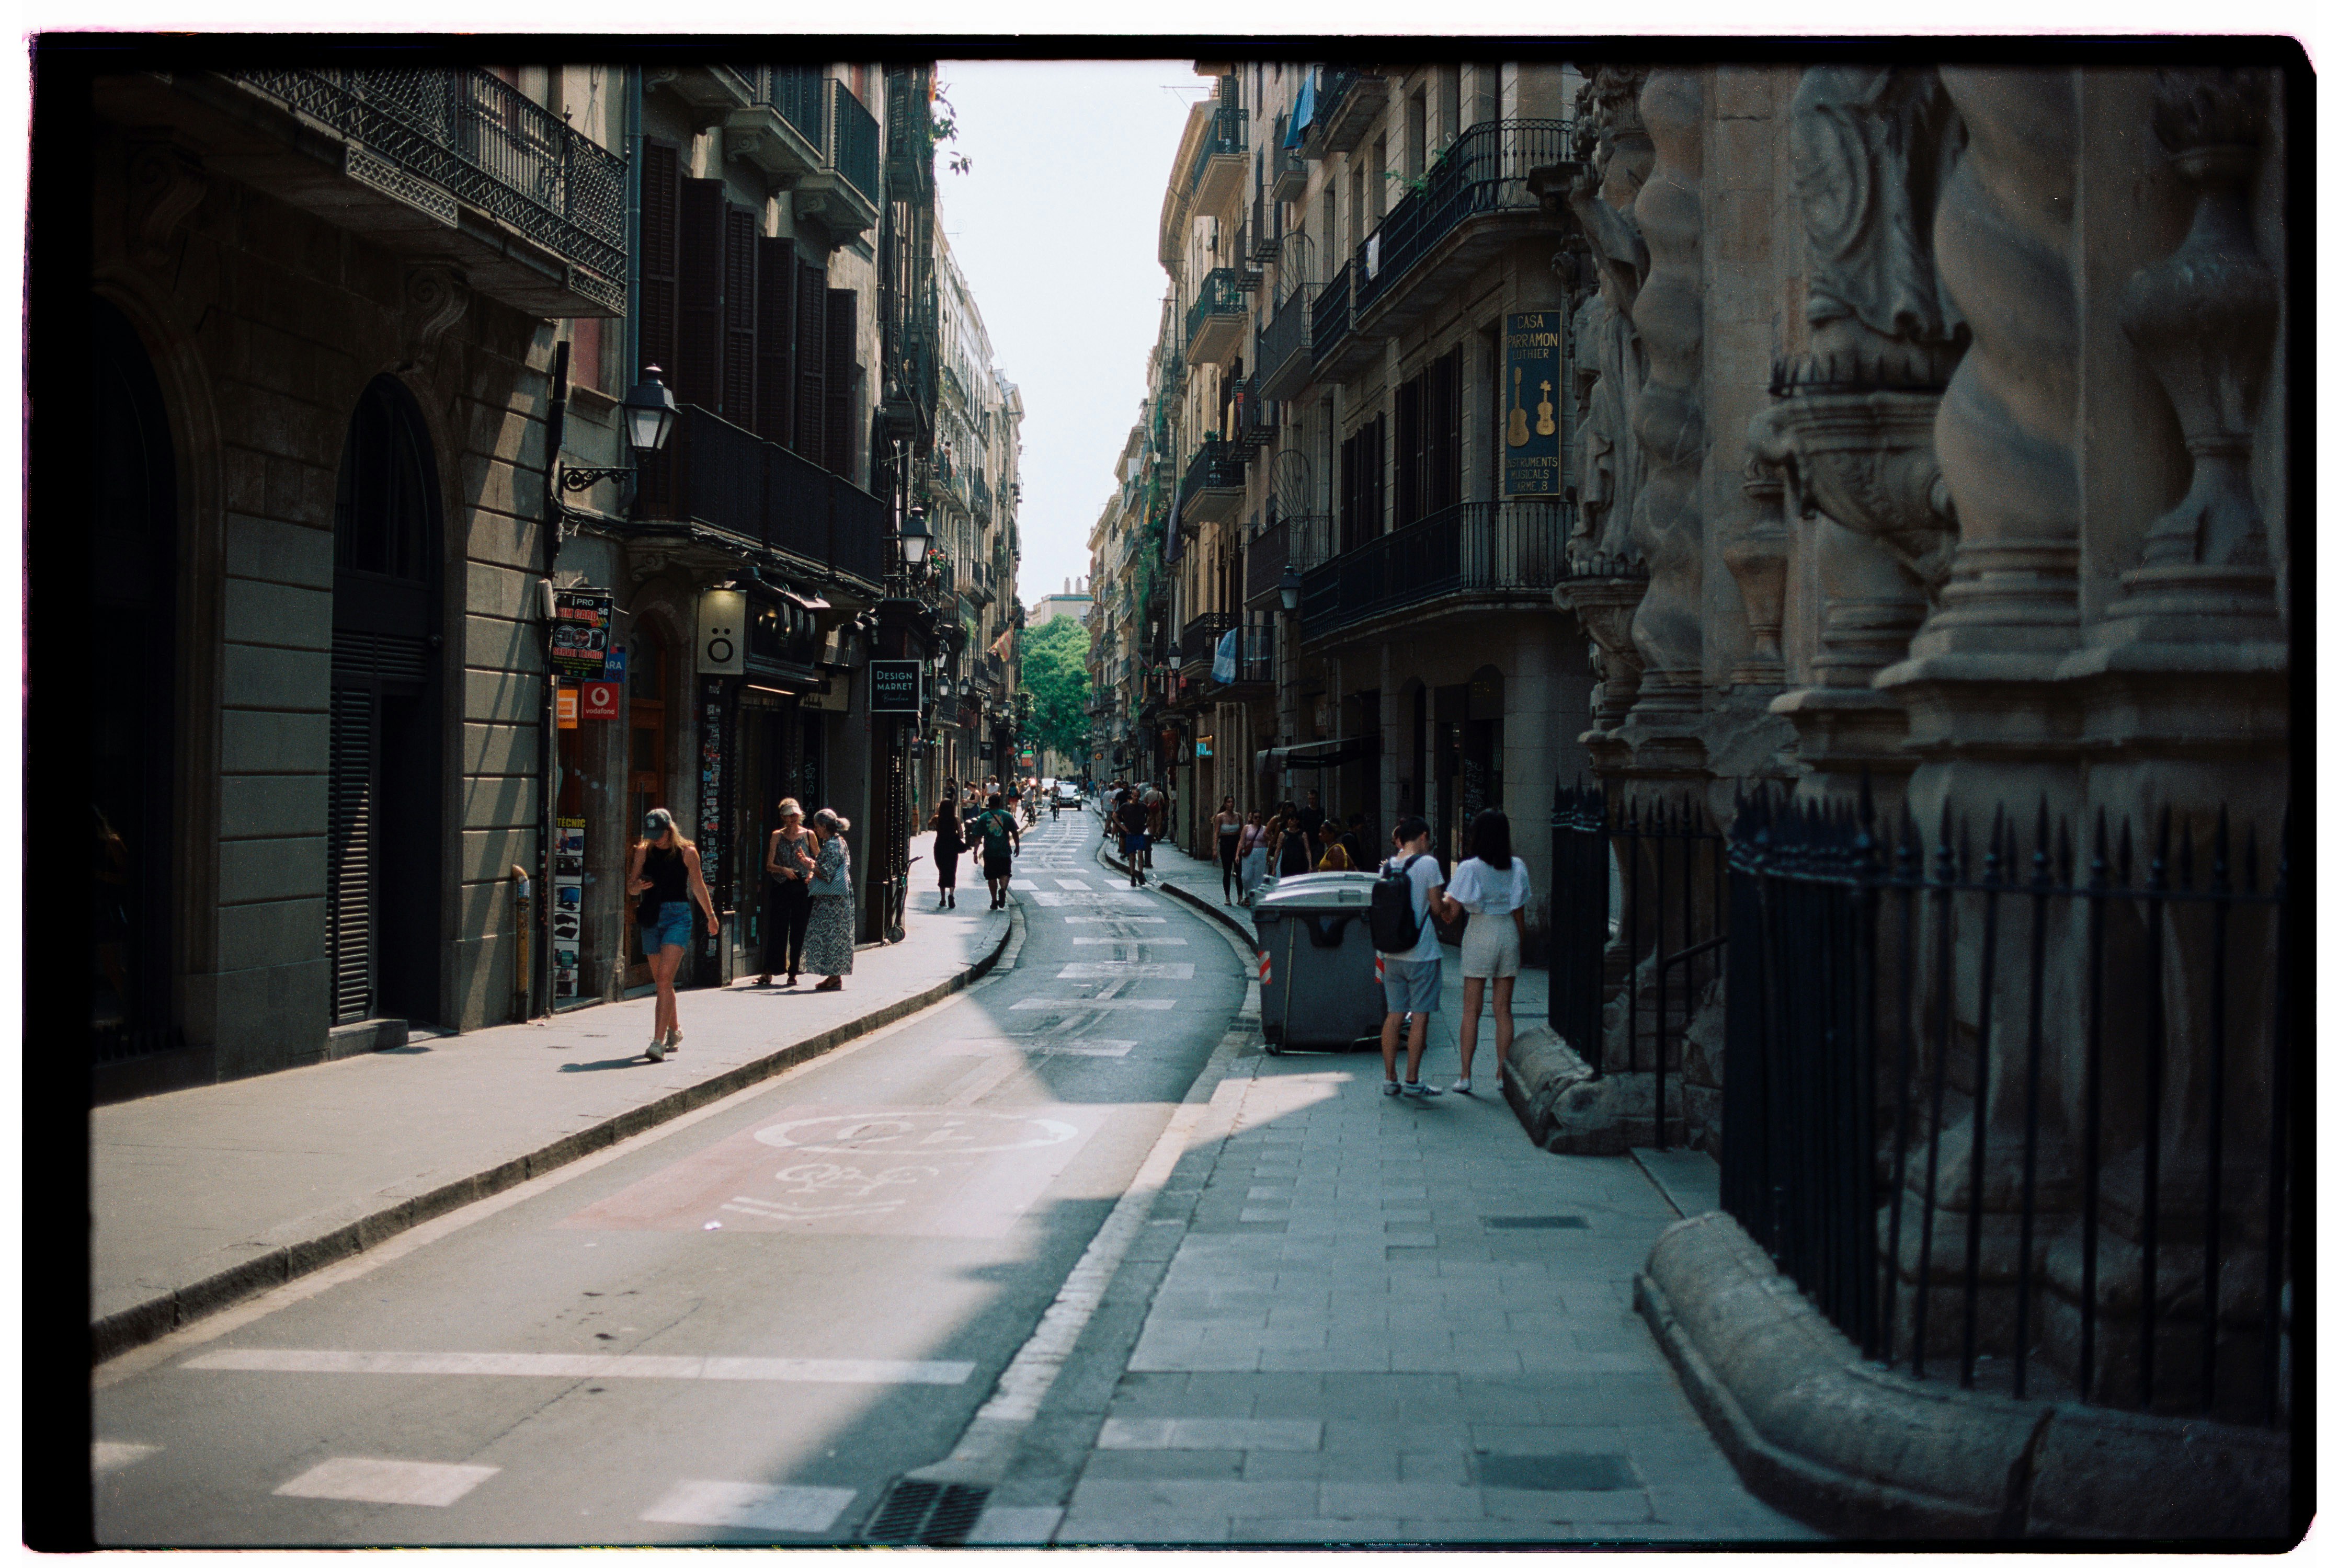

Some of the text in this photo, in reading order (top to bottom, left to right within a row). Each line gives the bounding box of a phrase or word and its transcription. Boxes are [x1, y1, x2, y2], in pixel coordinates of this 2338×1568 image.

[1518, 314, 1543, 328] CASA
[1508, 333, 1558, 349] PARRAMON
[1513, 349, 1549, 360] LUTHIER
[1507, 456, 1558, 468] INSTRUMENTS
[1511, 469, 1549, 479] MUSICALS
[557, 607, 598, 621] SIM CARD
[553, 646, 577, 657] SERVEI
[877, 671, 912, 680] DESIGN
